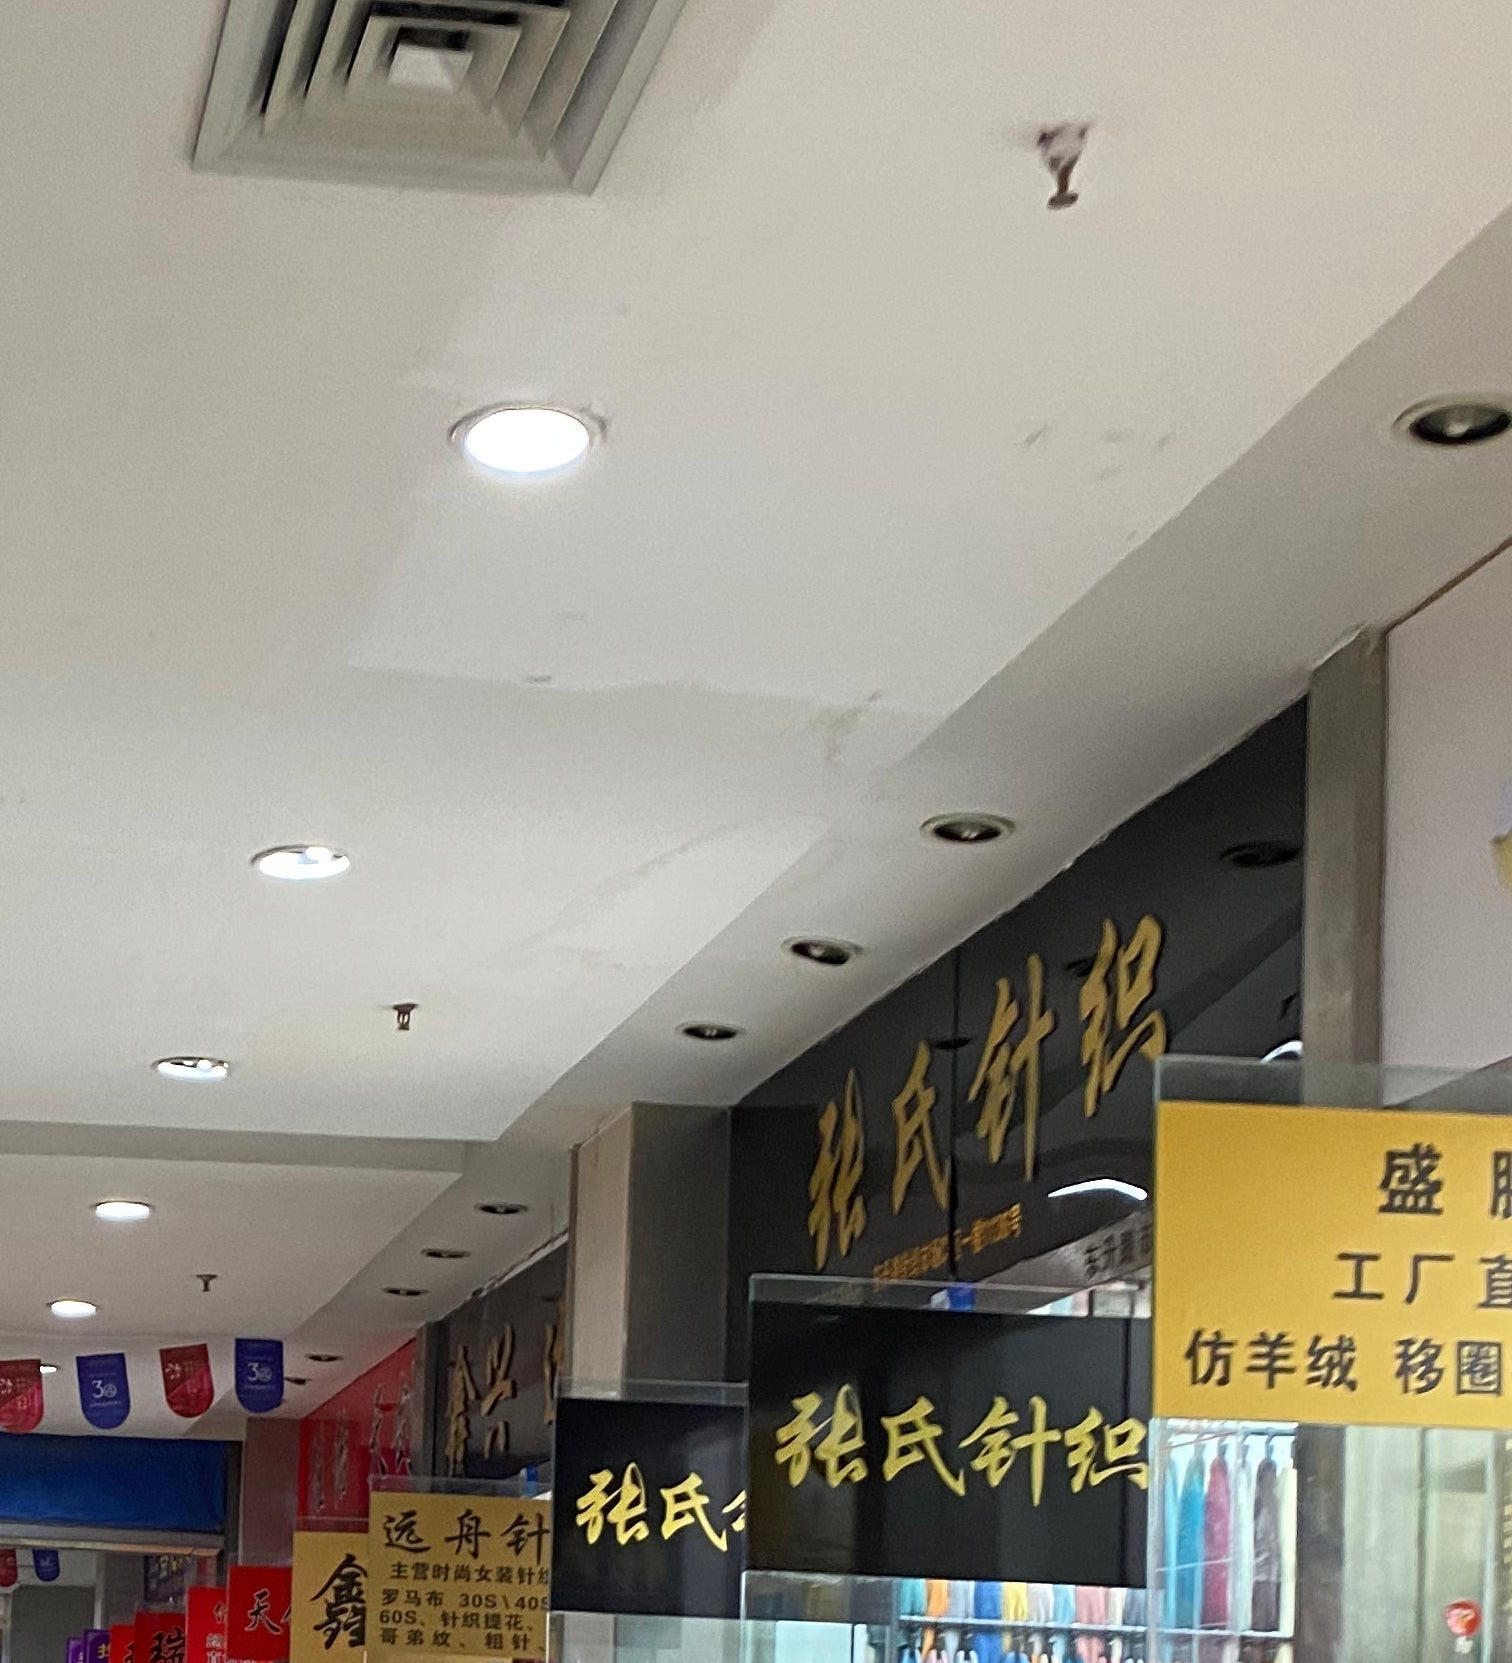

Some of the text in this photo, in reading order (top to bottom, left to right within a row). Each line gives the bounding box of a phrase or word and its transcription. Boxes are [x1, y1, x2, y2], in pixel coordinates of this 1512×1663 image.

[1184, 1327, 1502, 1397] 仿羊绒 移圈
[774, 1384, 1149, 1507] 张氏针织
[383, 1508, 550, 1565] 远舟针
[244, 1588, 292, 1636] 天
[382, 1588, 444, 1607] 罗马布
